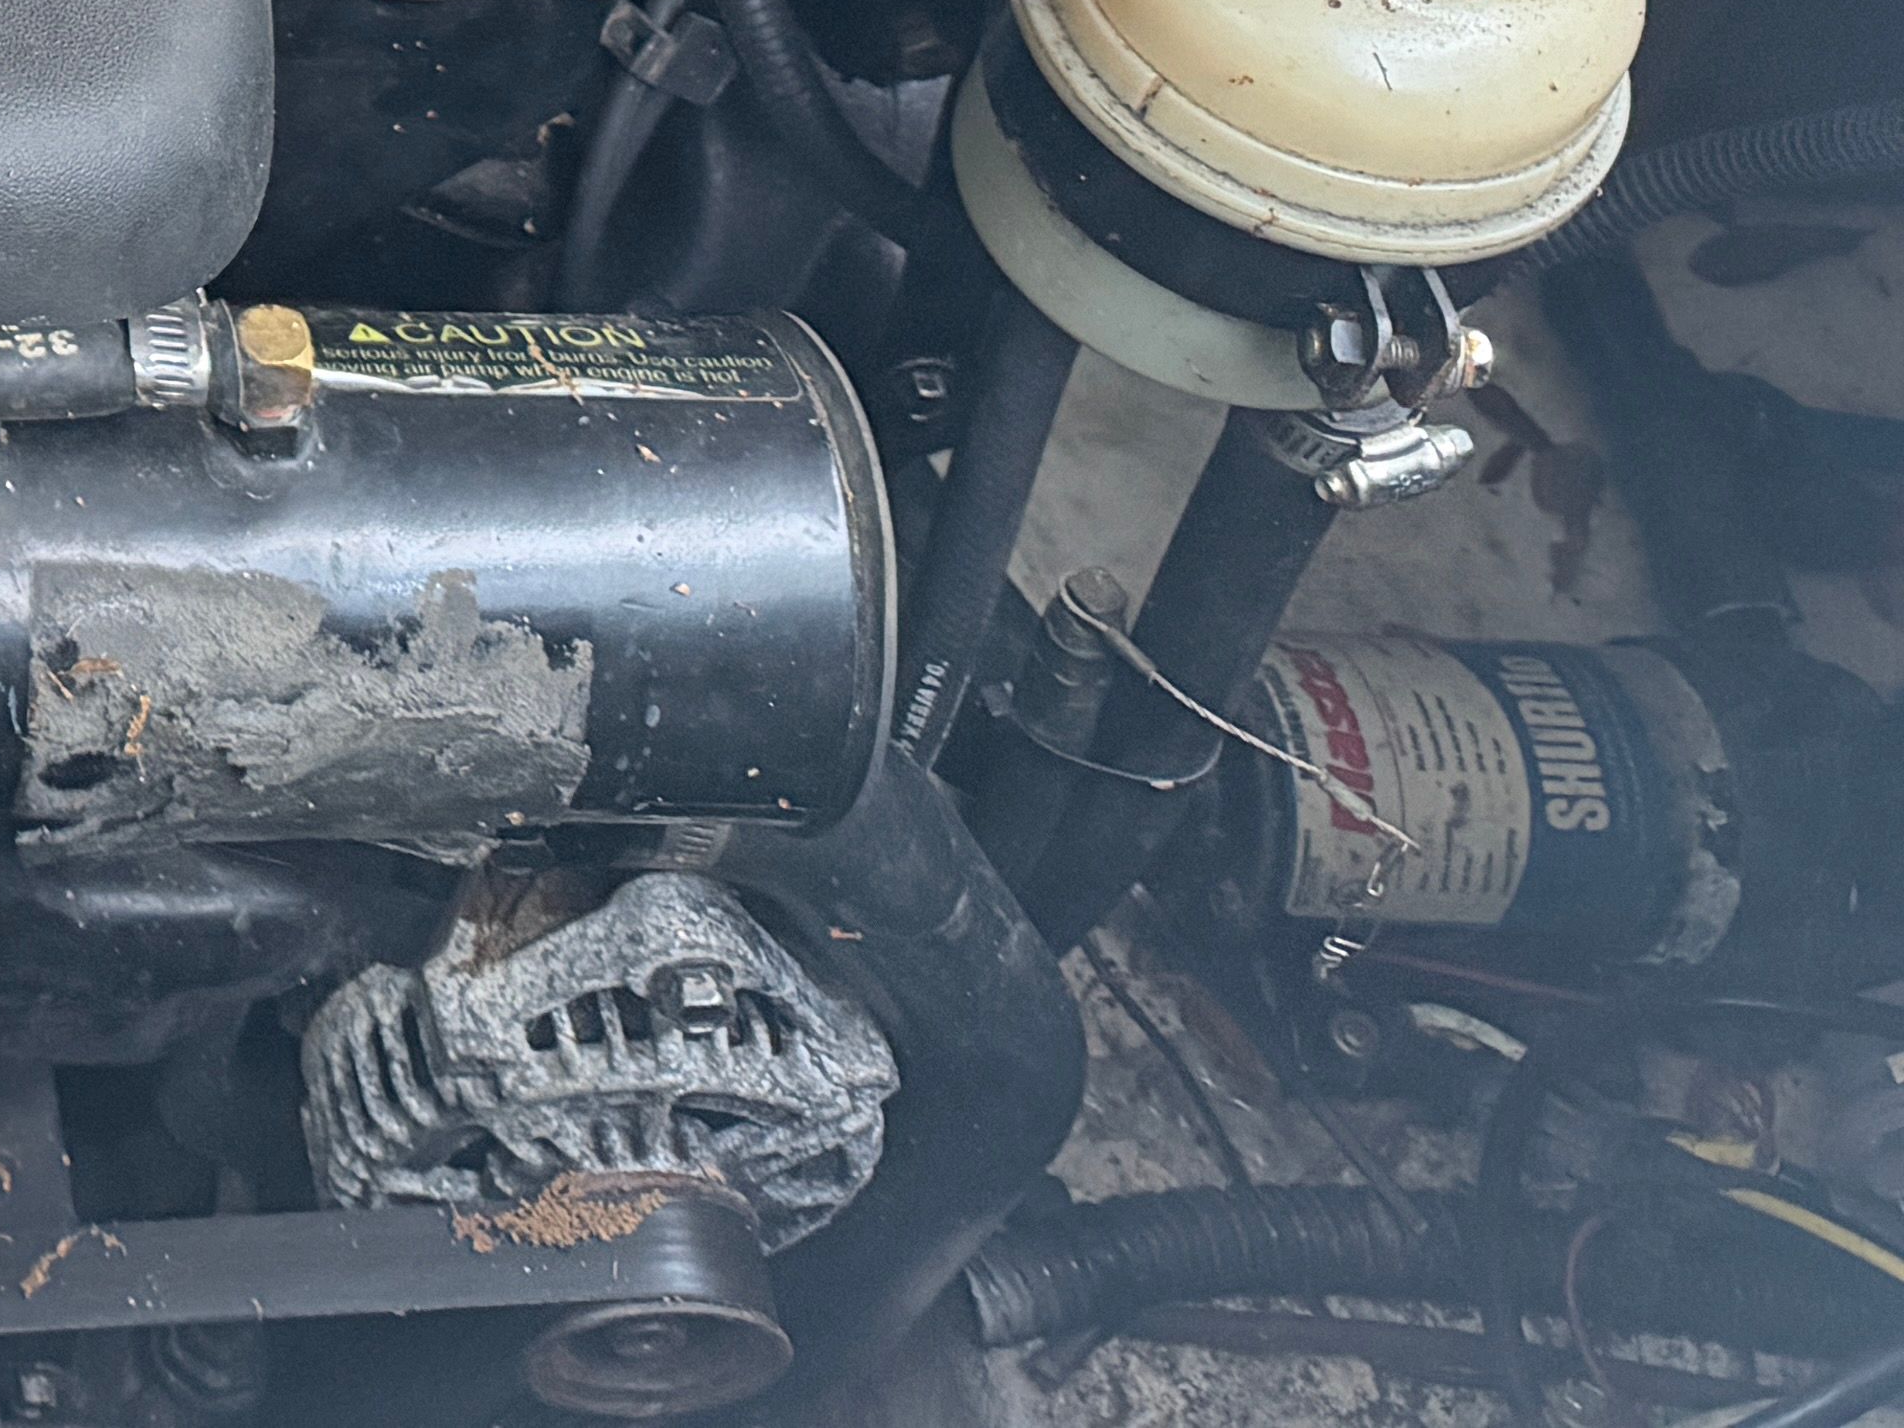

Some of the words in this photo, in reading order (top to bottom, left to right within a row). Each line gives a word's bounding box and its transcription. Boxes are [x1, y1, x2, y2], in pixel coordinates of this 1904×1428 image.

[393, 322, 648, 349] CAUTION
[322, 347, 409, 361] serious
[416, 348, 480, 364] injury
[404, 361, 432, 375] air
[440, 363, 510, 380] pump
[586, 366, 670, 383] engine
[674, 369, 694, 382] is
